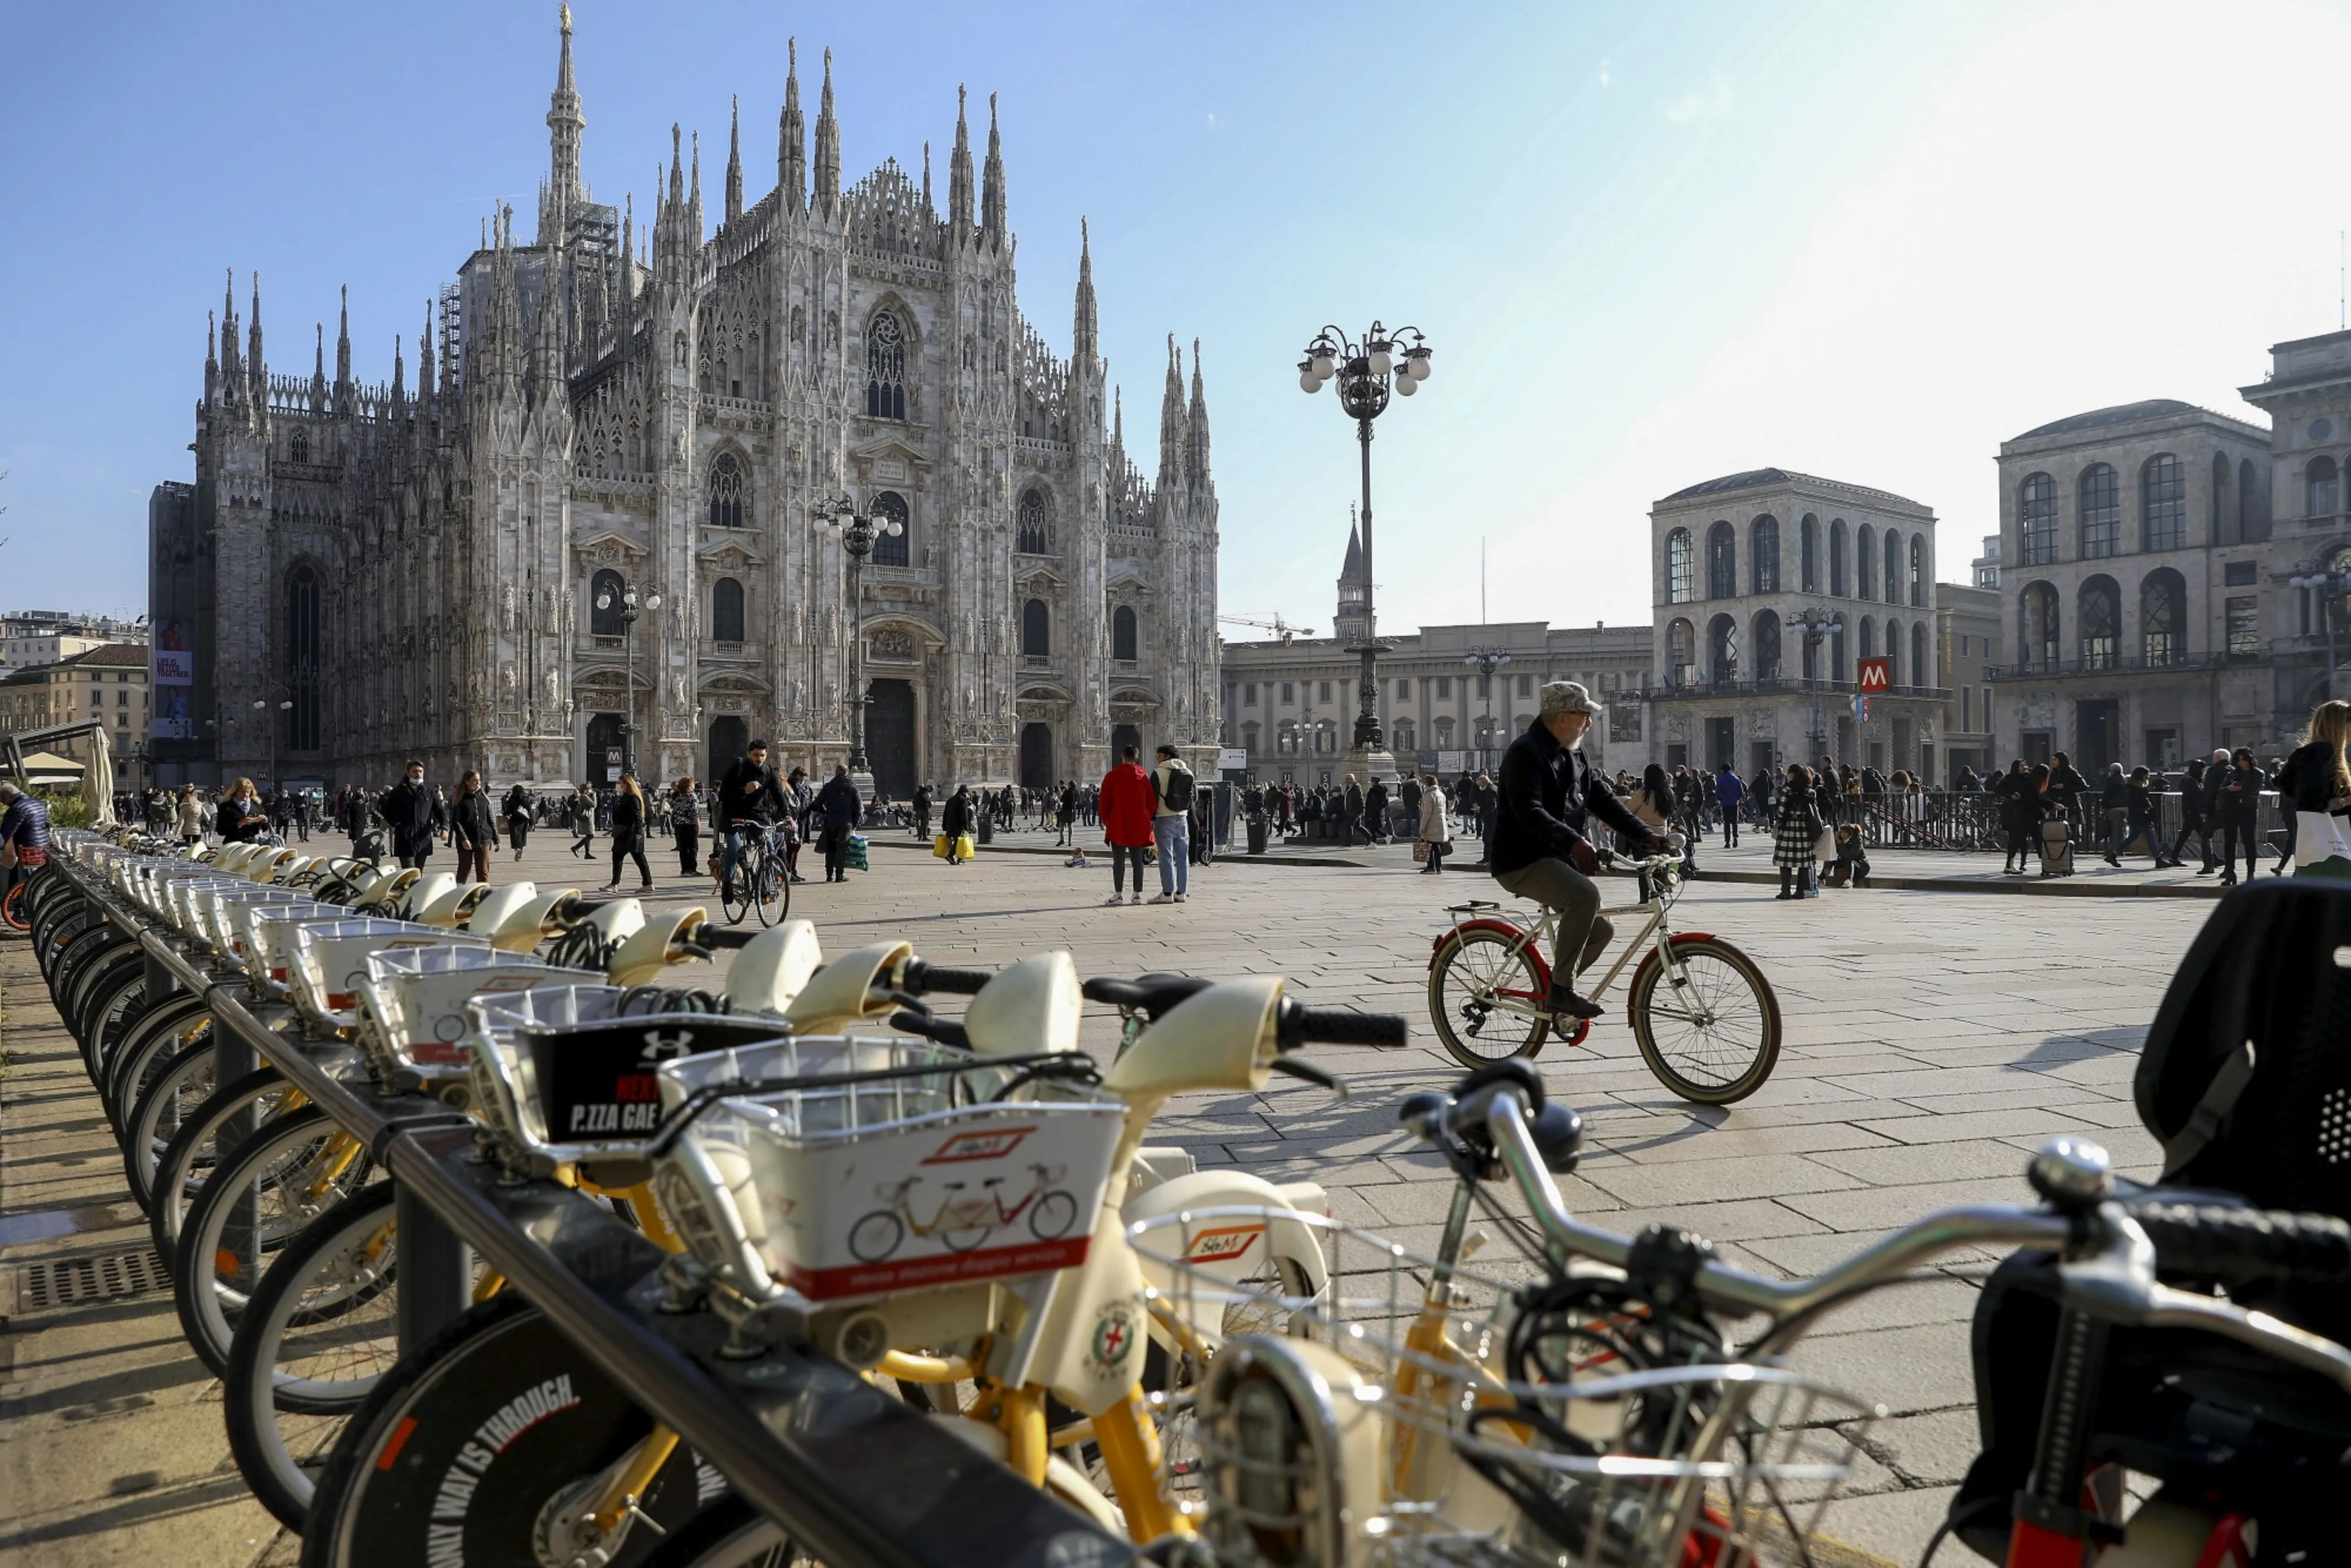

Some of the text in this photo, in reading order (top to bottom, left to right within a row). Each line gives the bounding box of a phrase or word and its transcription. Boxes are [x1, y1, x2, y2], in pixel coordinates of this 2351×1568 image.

[1862, 666, 1886, 686] M
[608, 751, 620, 761] M
[570, 1103, 657, 1132] P.ZZA GAE
[474, 1373, 580, 1452] THROUGH.
[456, 1441, 494, 1474] IS
[433, 1465, 480, 1518] WAY
